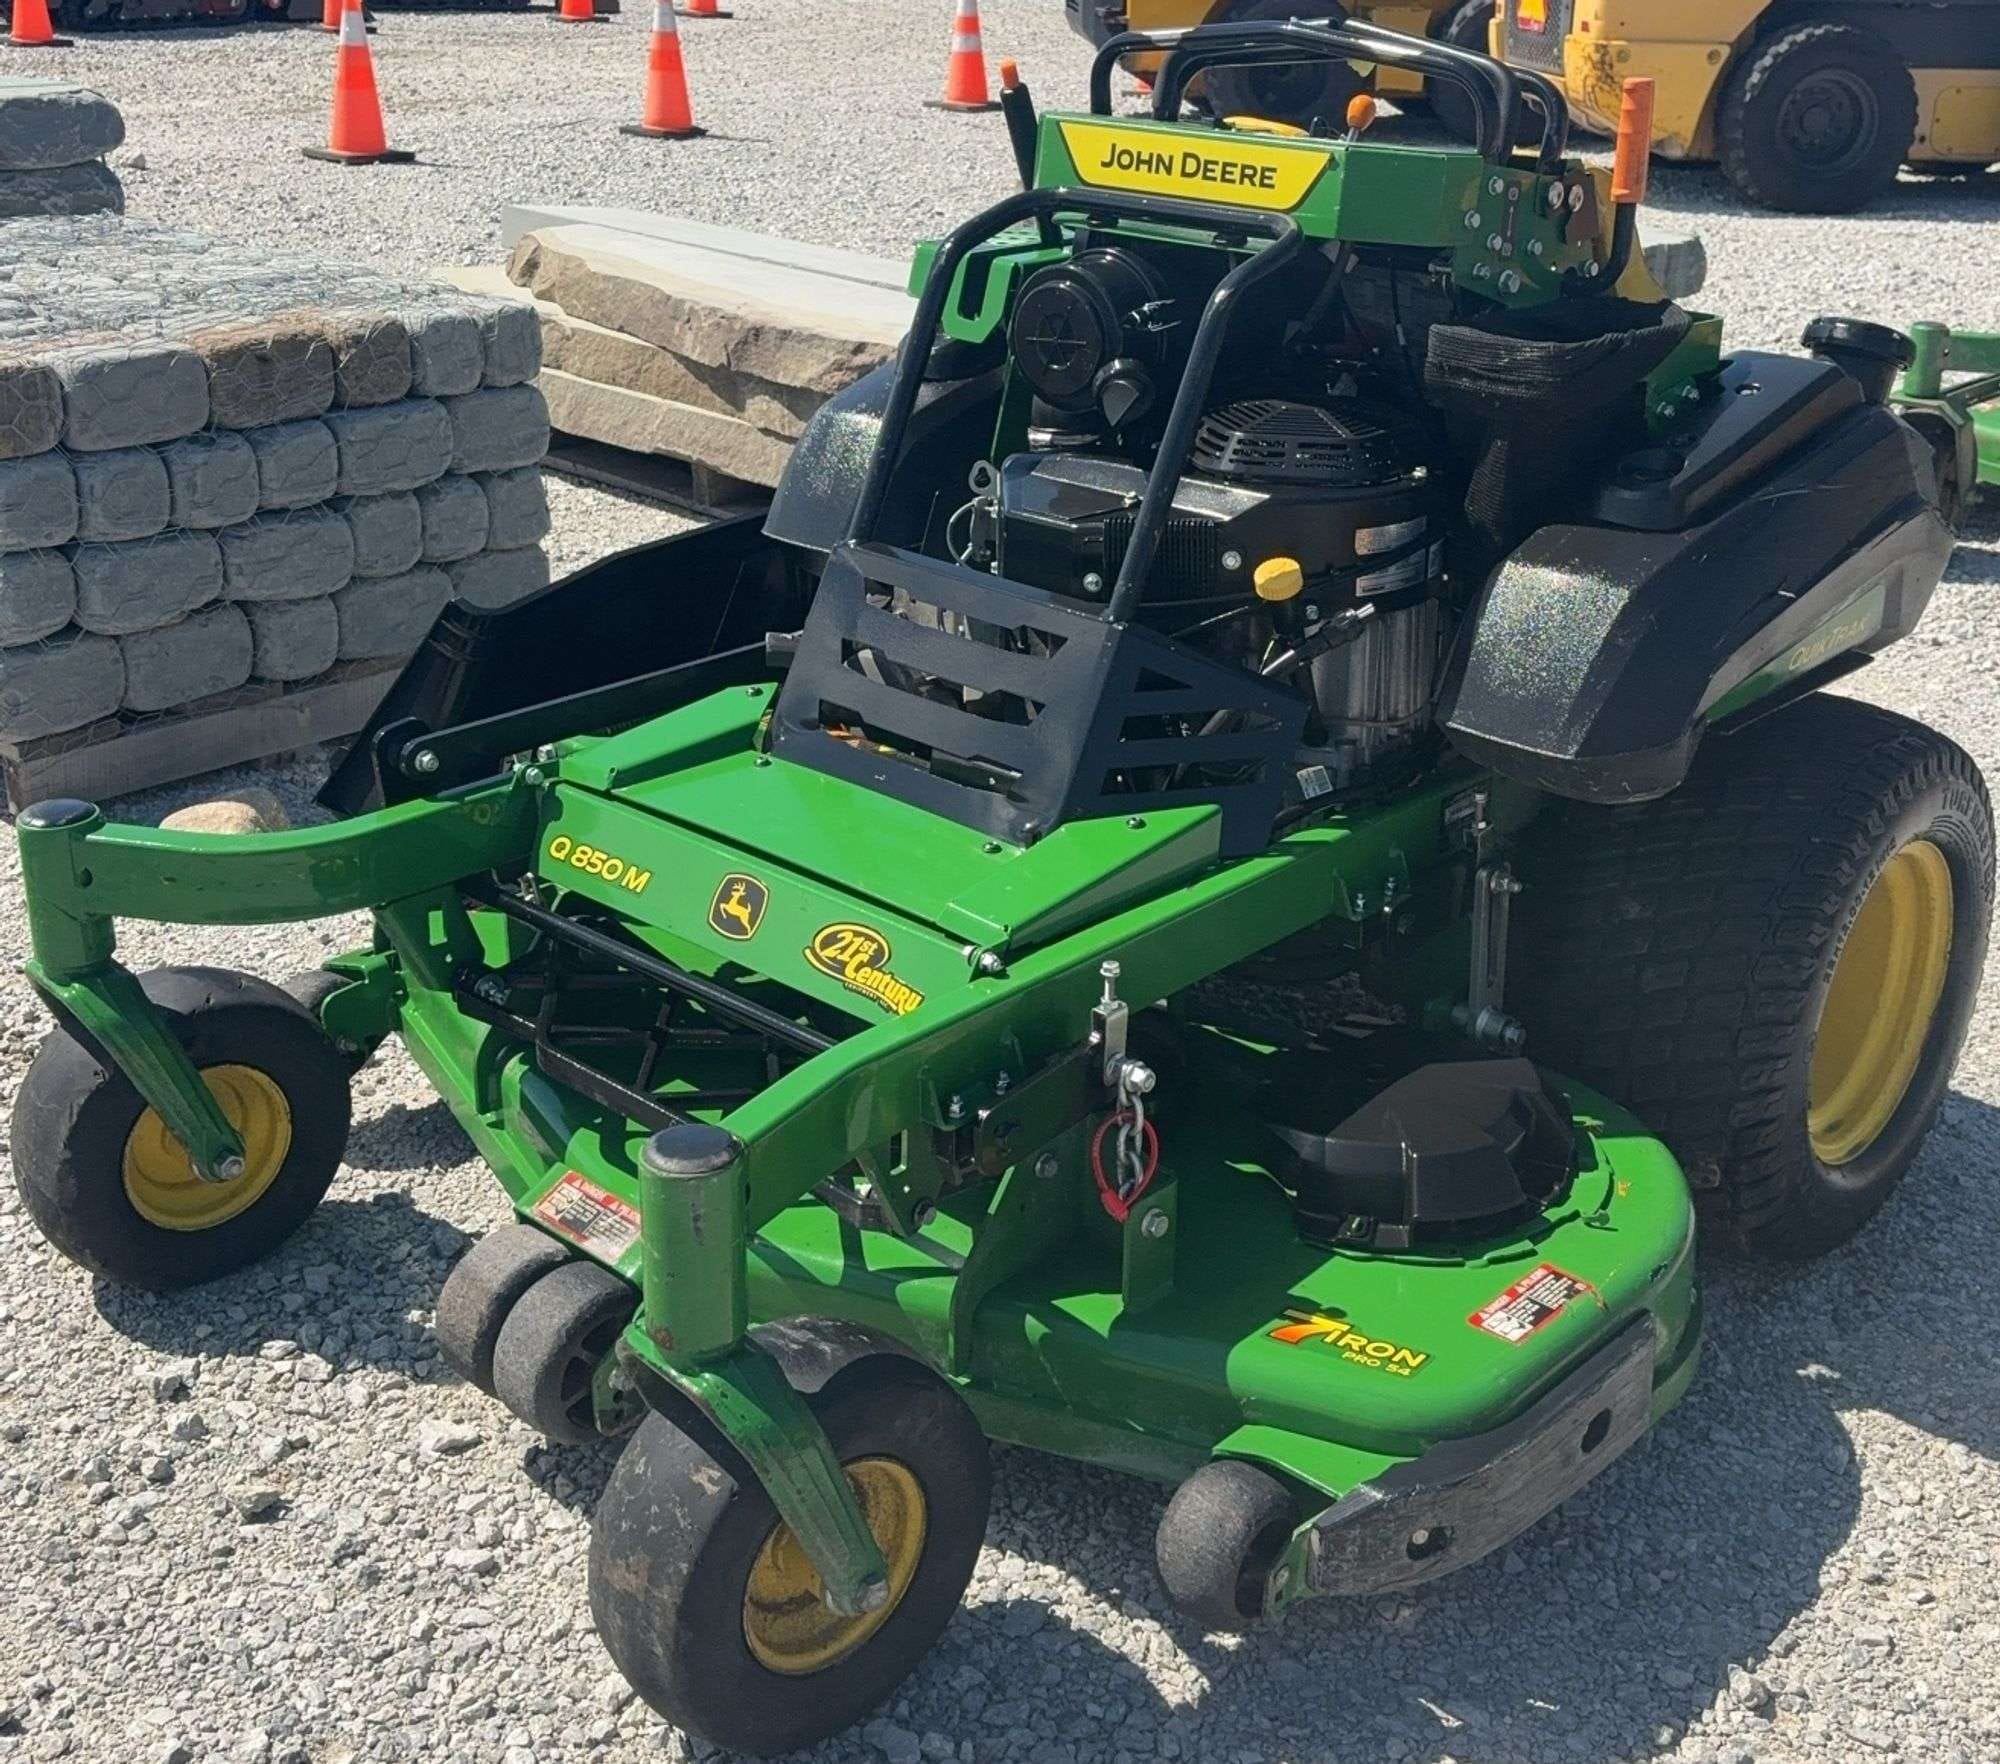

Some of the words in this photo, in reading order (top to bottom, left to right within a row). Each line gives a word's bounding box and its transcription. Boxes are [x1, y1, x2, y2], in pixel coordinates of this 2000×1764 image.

[1100, 143, 1173, 176] JOHN
[1180, 152, 1278, 190] DEERE
[549, 836, 572, 861] Q
[570, 844, 624, 881] 850
[620, 865, 652, 893] M
[820, 930, 878, 962] 21st
[1267, 1308, 1352, 1345] 7
[1322, 1329, 1428, 1368] IRON
[1341, 1351, 1382, 1367] PRO
[1384, 1363, 1412, 1377] 54
